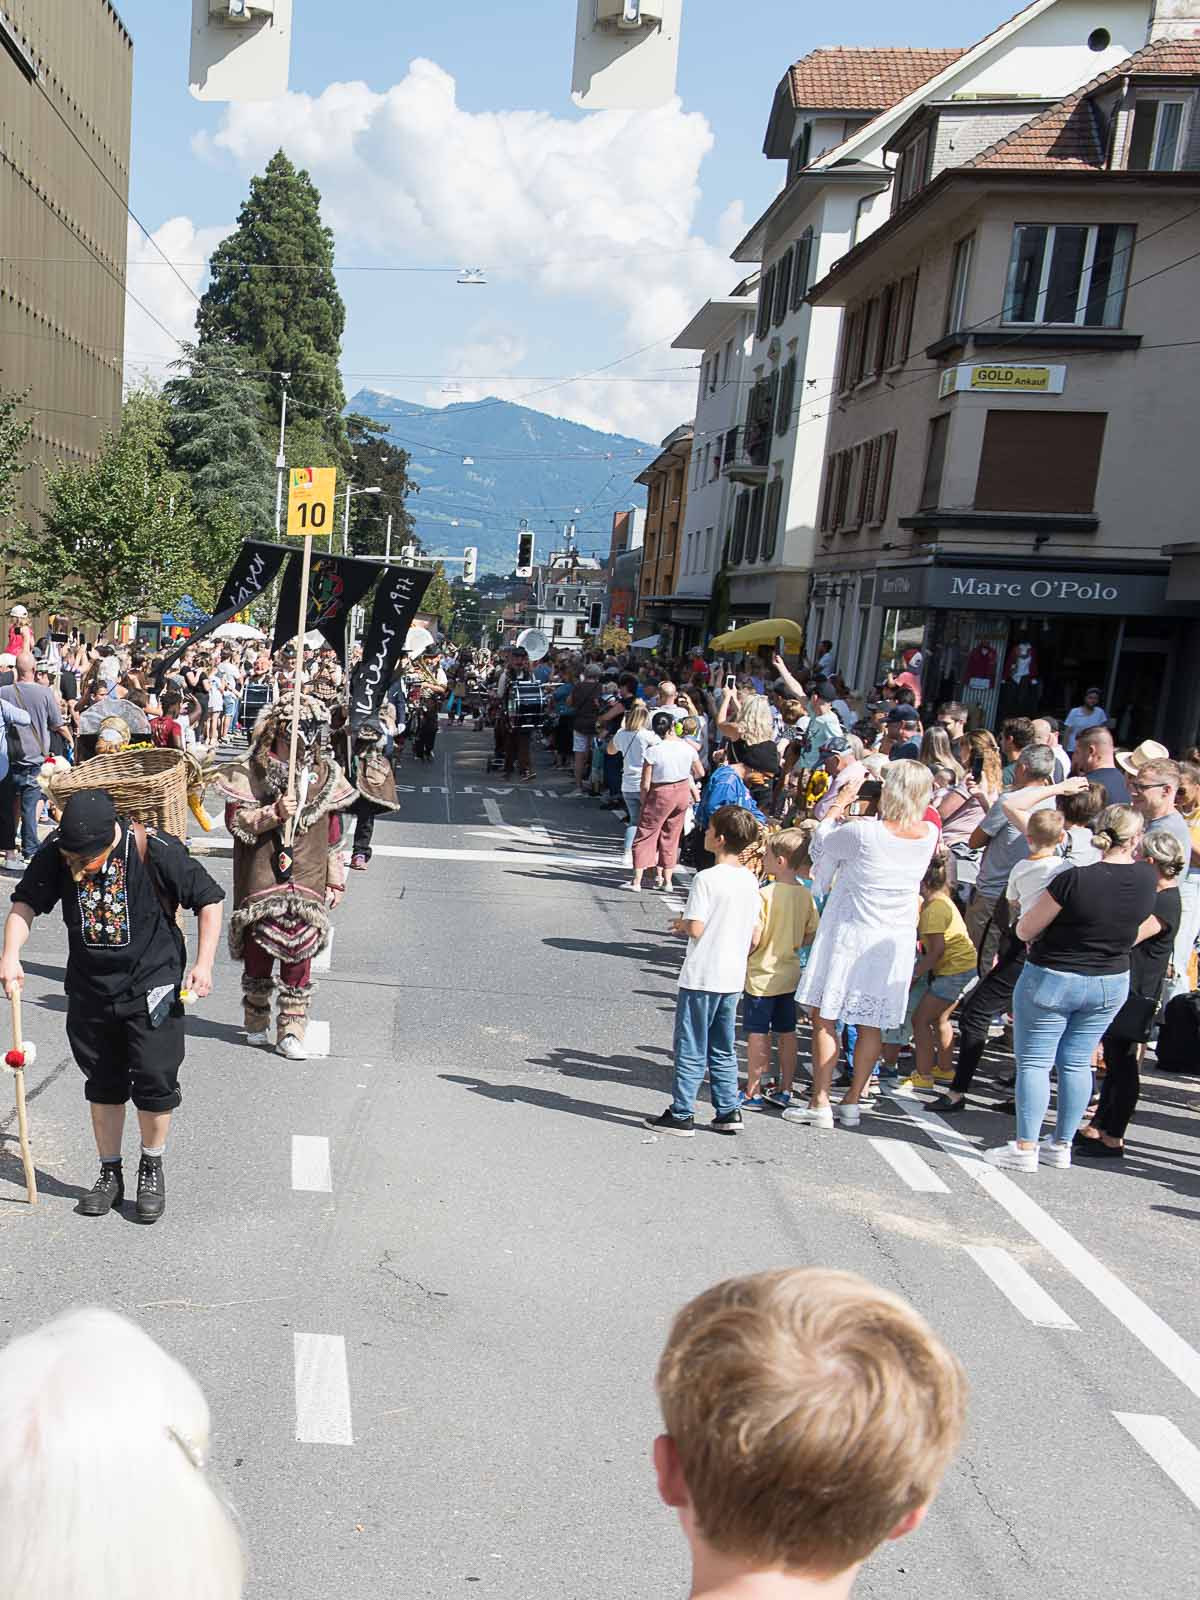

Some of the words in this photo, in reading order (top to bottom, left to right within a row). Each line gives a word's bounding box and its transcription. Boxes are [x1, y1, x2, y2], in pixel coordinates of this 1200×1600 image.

[978, 370, 1014, 381] GOLD
[297, 502, 326, 528] 10
[951, 577, 1021, 596] Marc
[1031, 580, 1118, 600] O'Polo
[356, 623, 395, 716] Kriens
[390, 577, 415, 615] 1977
